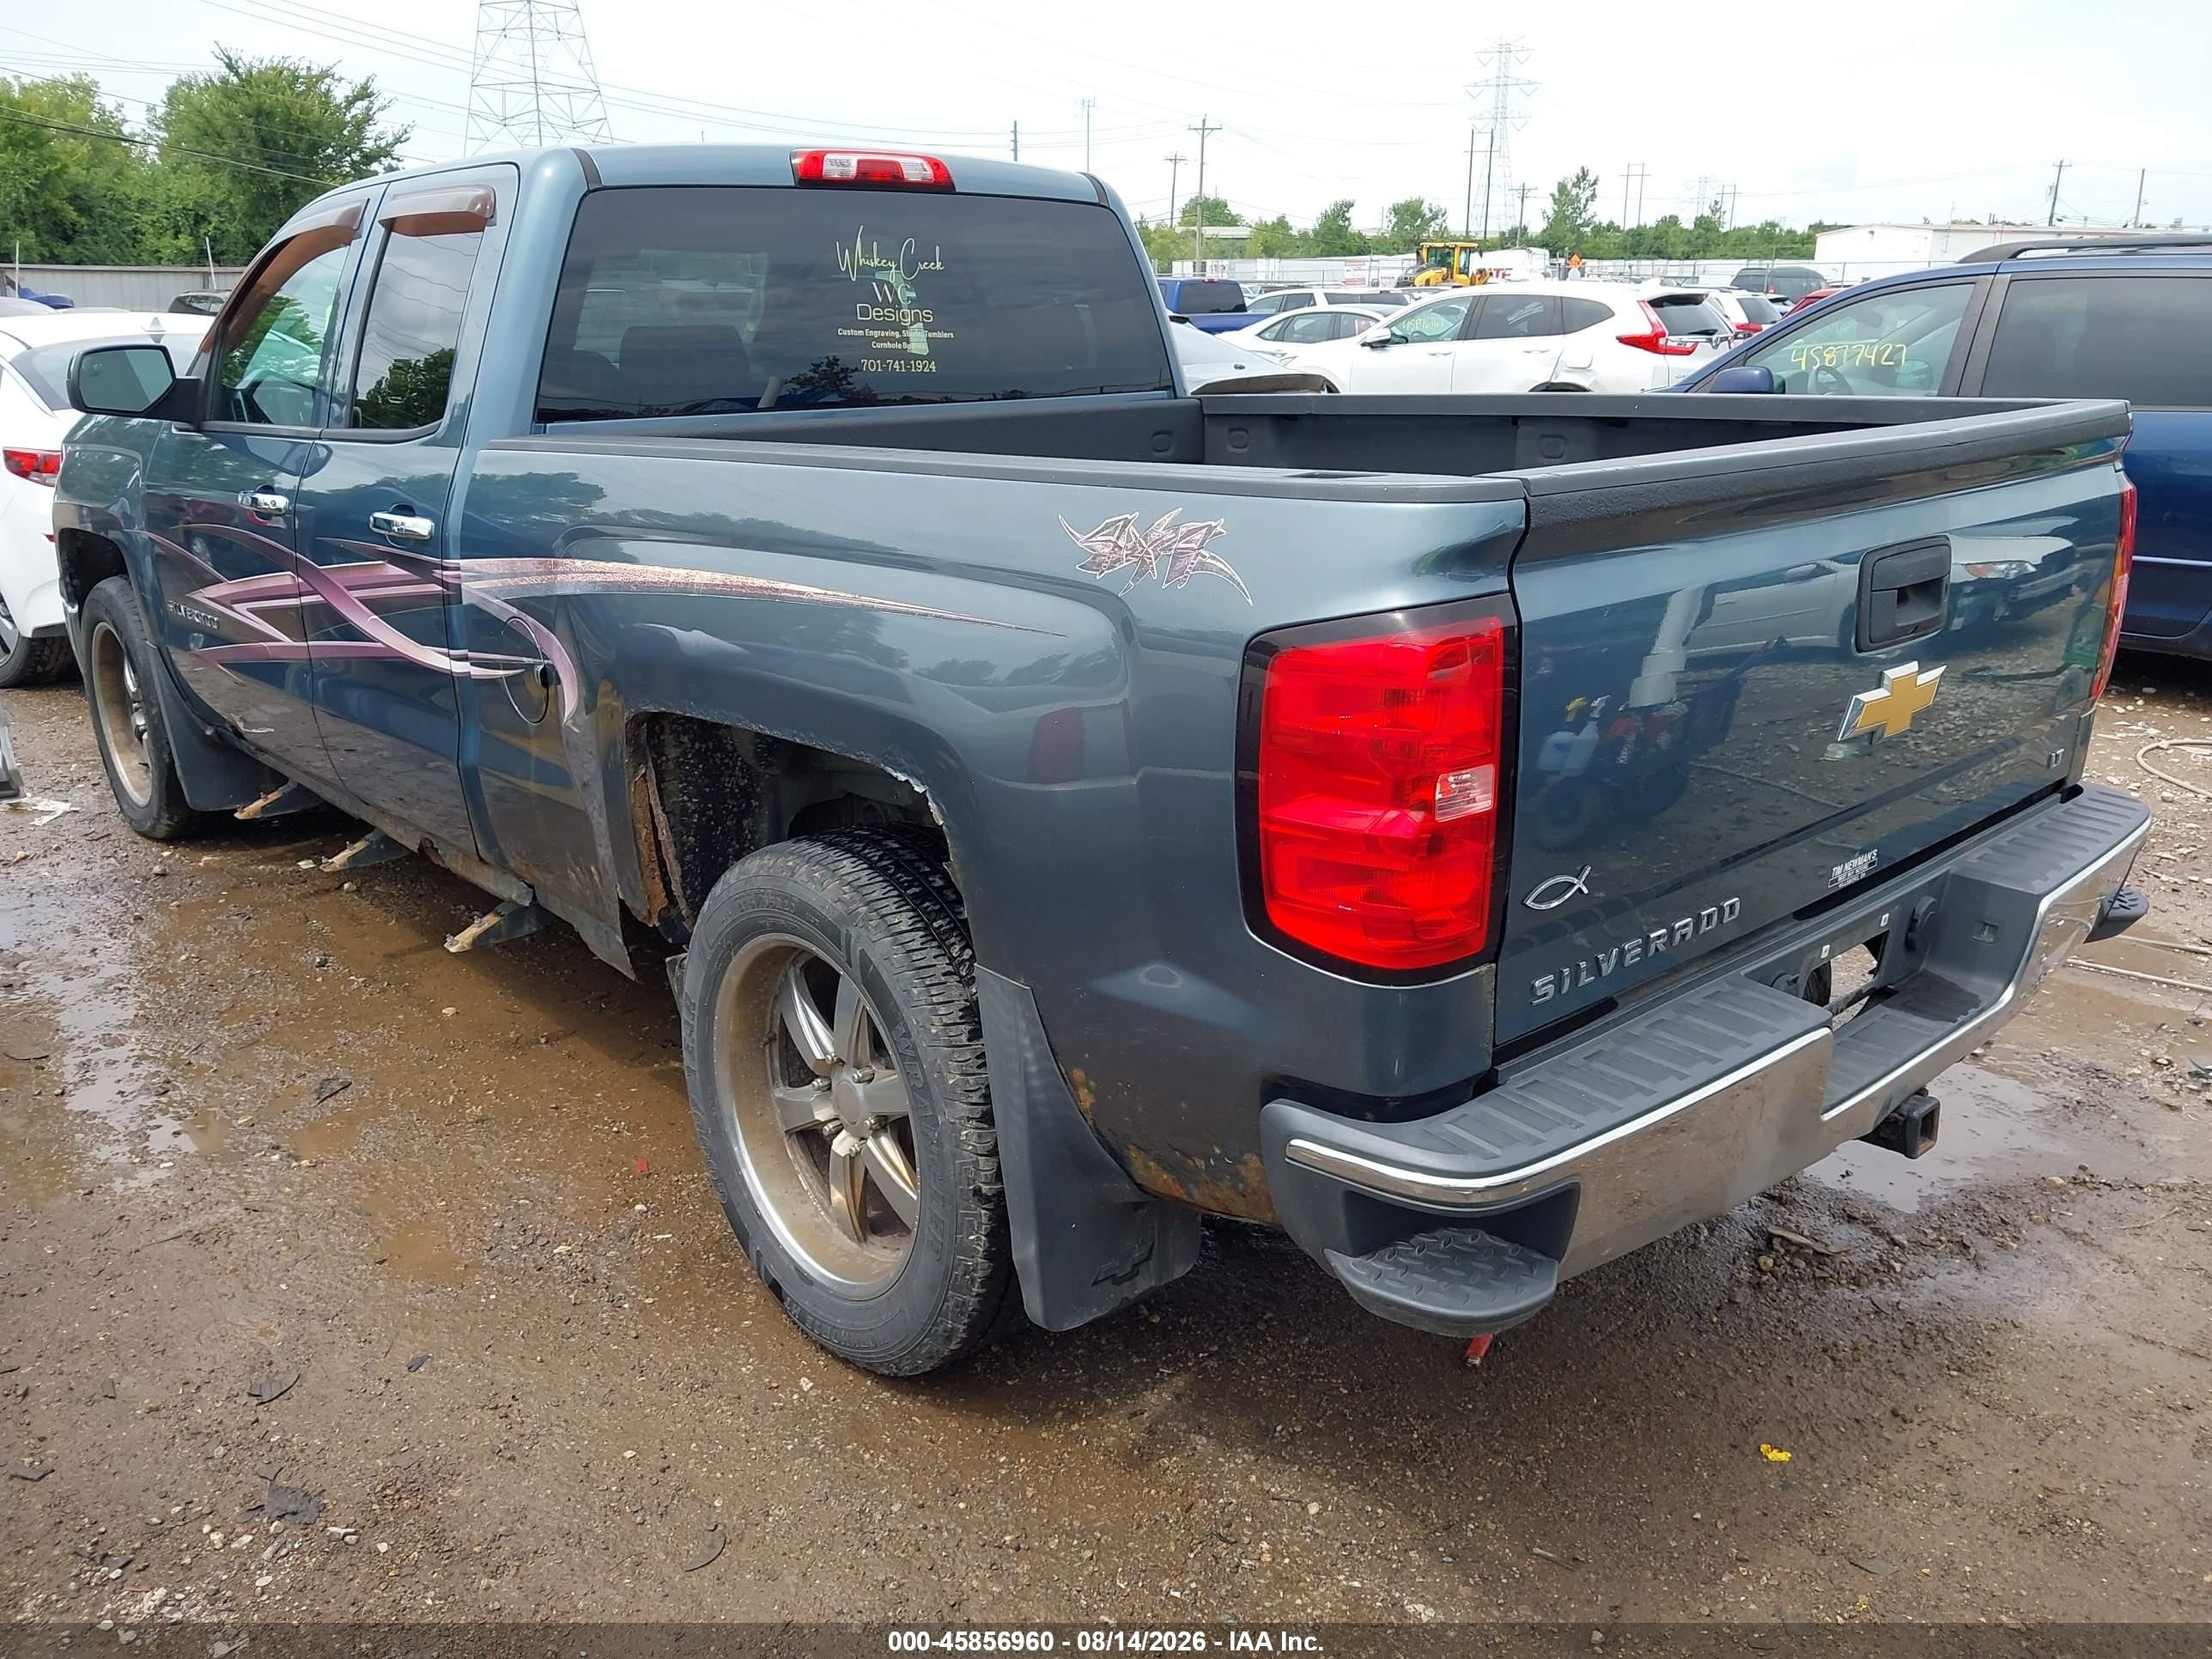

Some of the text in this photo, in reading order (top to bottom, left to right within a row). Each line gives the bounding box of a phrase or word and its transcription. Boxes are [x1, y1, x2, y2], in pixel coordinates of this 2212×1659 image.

[836, 225, 945, 284] Whiskey Creek
[856, 303, 933, 326] Designs
[837, 328, 864, 337] Custom
[925, 331, 954, 339] Tumblers
[861, 359, 937, 373] 701-741-1924
[1790, 343, 1907, 371] 45877427
[1530, 896, 1741, 1006] SILVERADO
